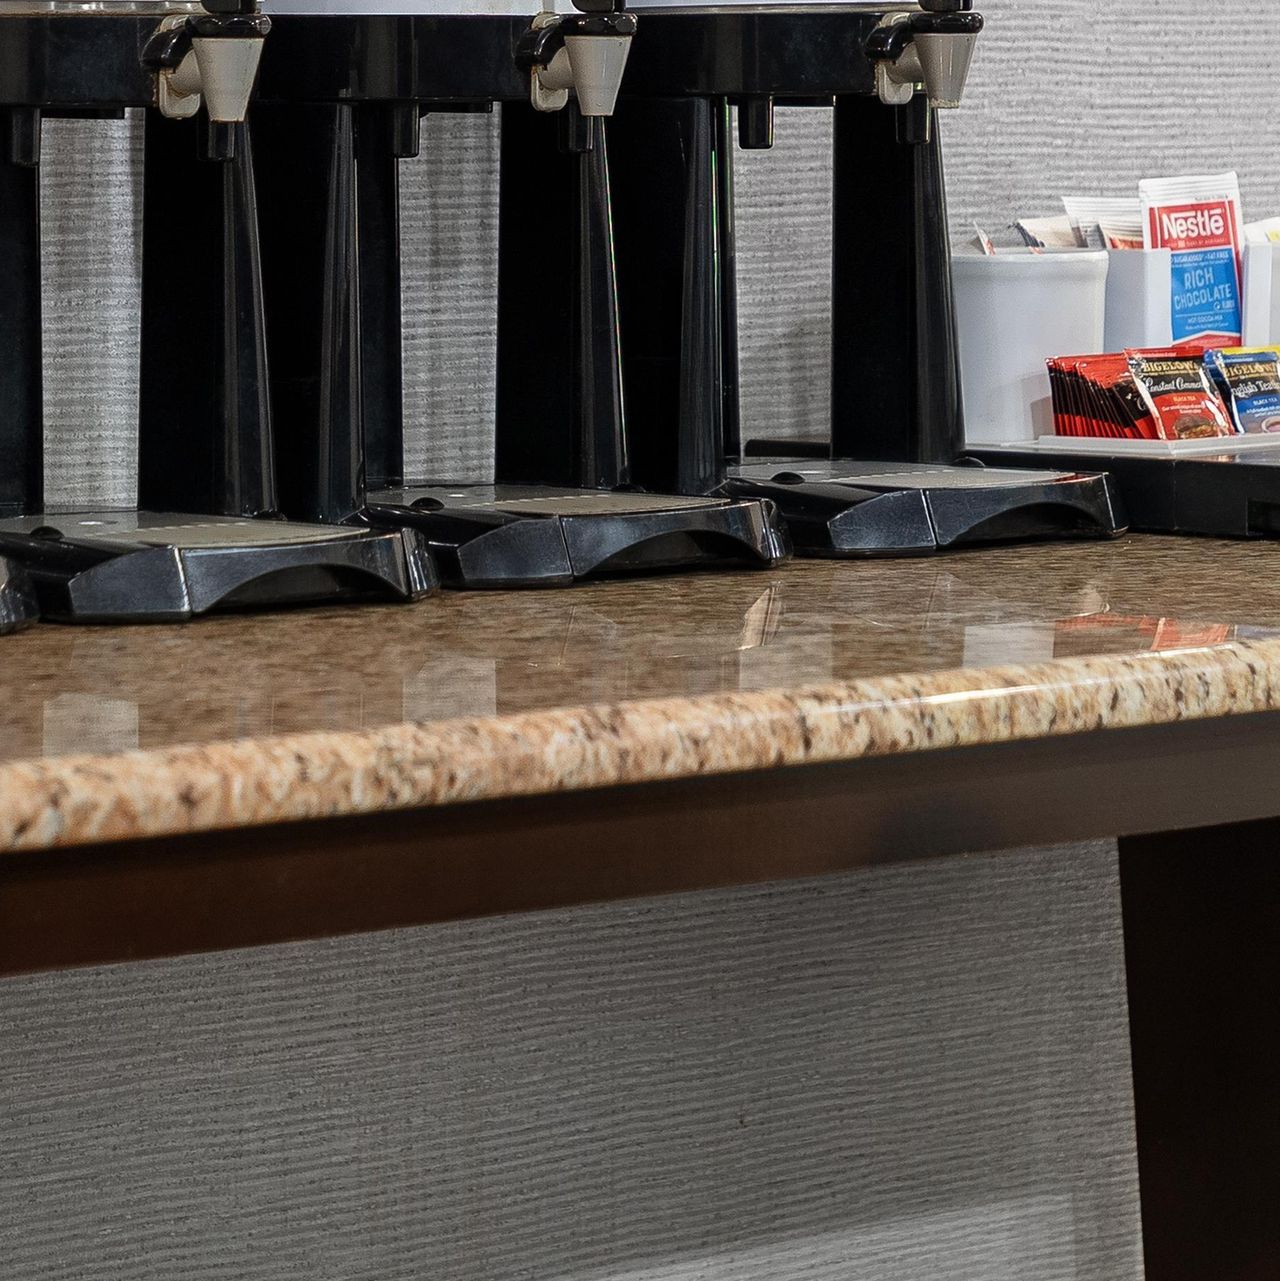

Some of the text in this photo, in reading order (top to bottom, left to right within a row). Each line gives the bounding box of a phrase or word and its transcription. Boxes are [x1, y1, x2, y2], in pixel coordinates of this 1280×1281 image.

[1161, 208, 1225, 240] Nestlé
[1184, 267, 1214, 290] RICH
[1174, 283, 1232, 310] CHOCOLATE
[1144, 361, 1198, 372] BIGELOW
[1231, 382, 1257, 398] nglish
